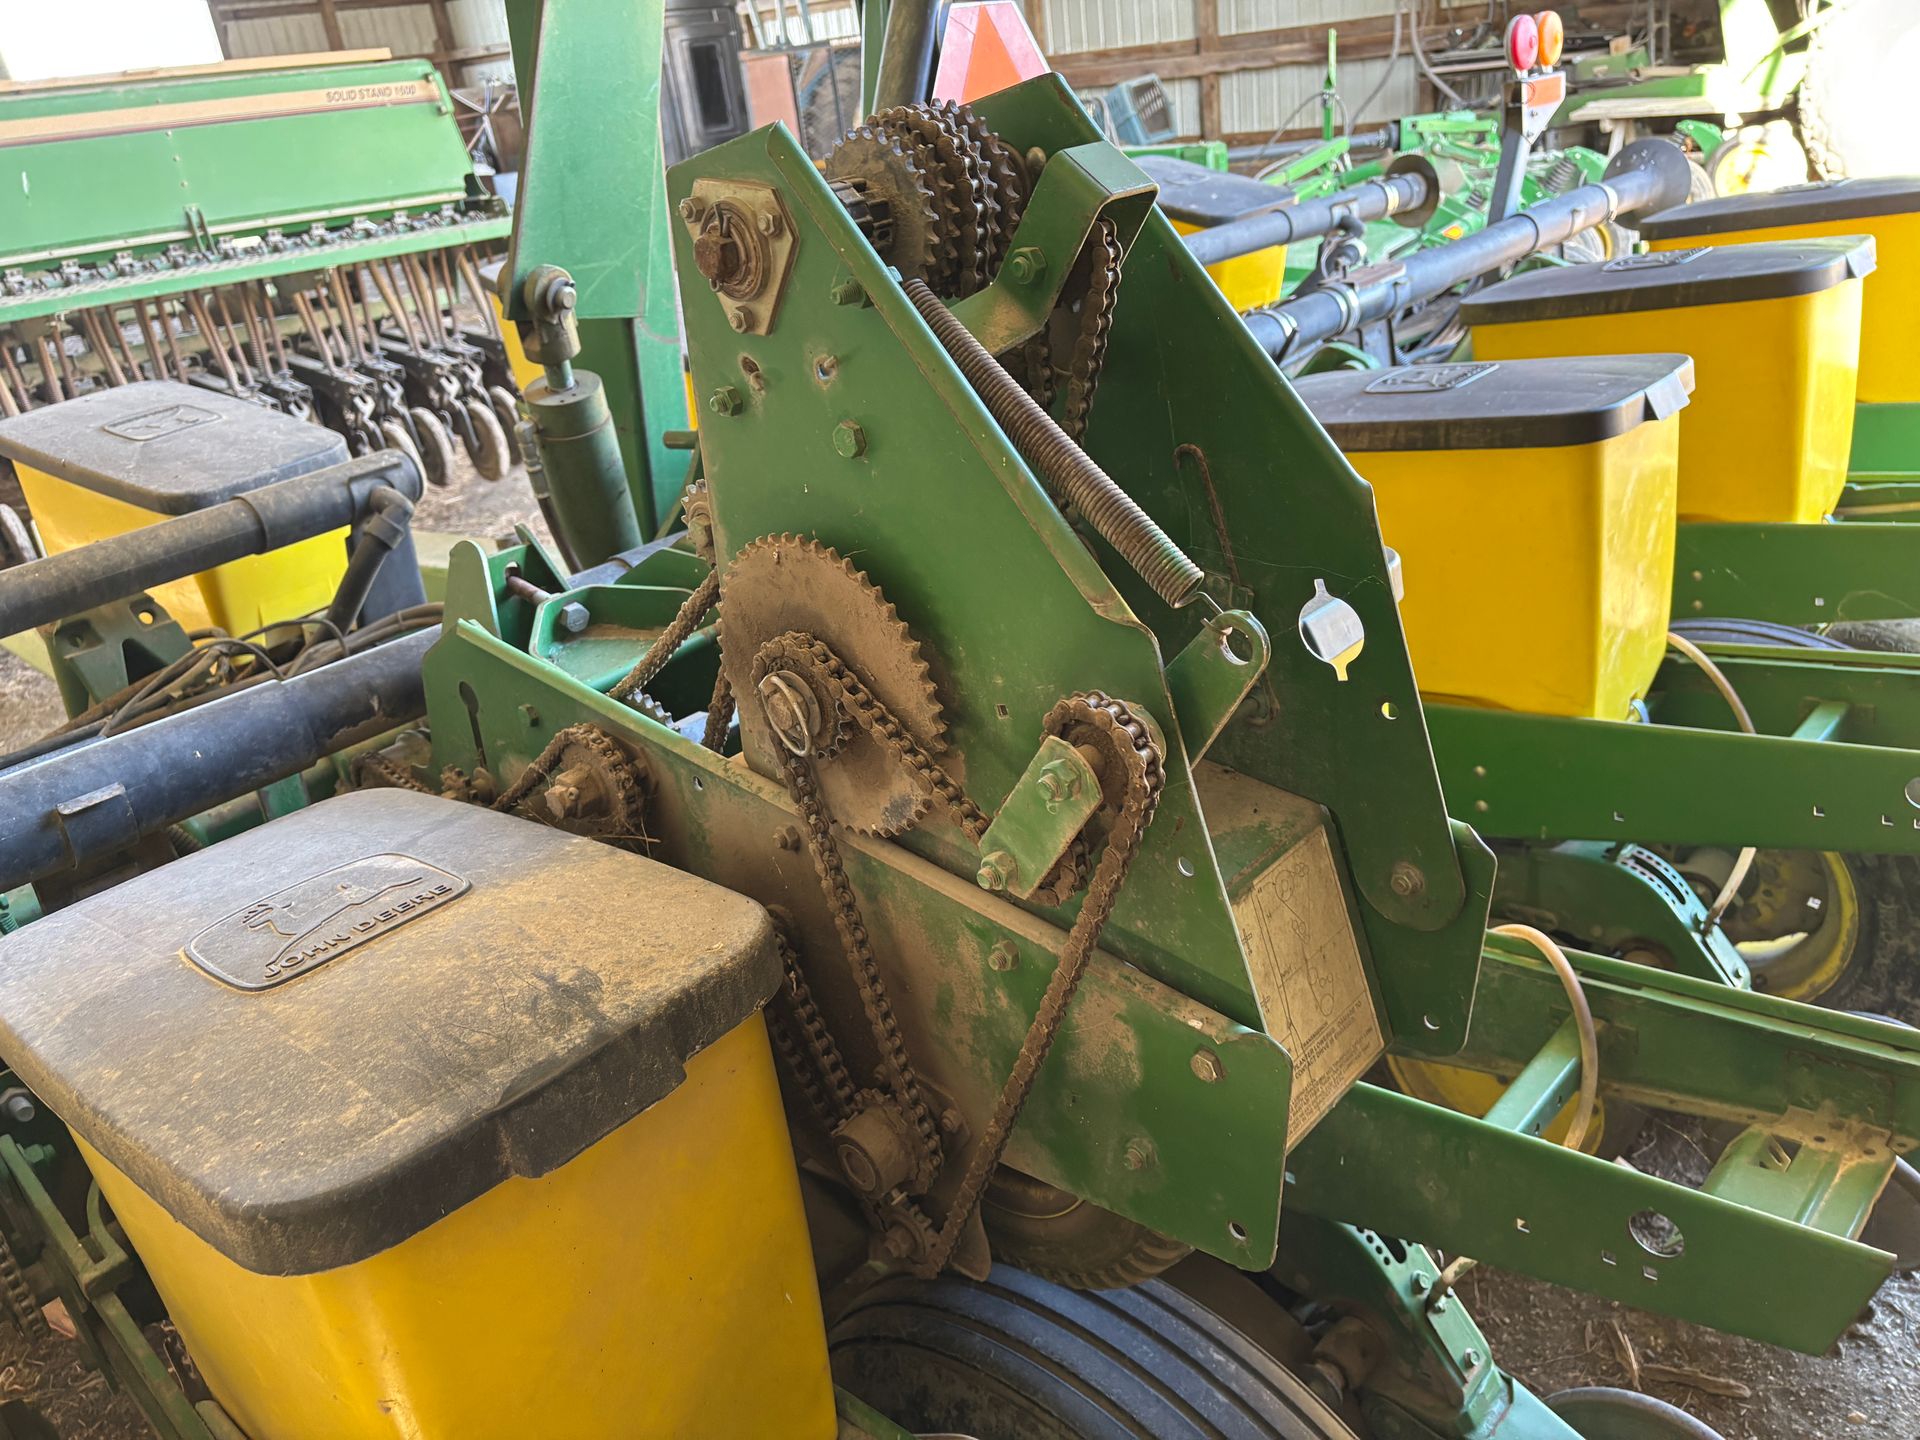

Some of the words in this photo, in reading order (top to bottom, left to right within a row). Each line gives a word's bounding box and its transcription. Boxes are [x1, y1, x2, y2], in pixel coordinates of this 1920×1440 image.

[326, 88, 357, 103] SOLID
[358, 85, 393, 100] STAND
[264, 932, 352, 980] JOHN
[353, 884, 452, 933] DEERE
